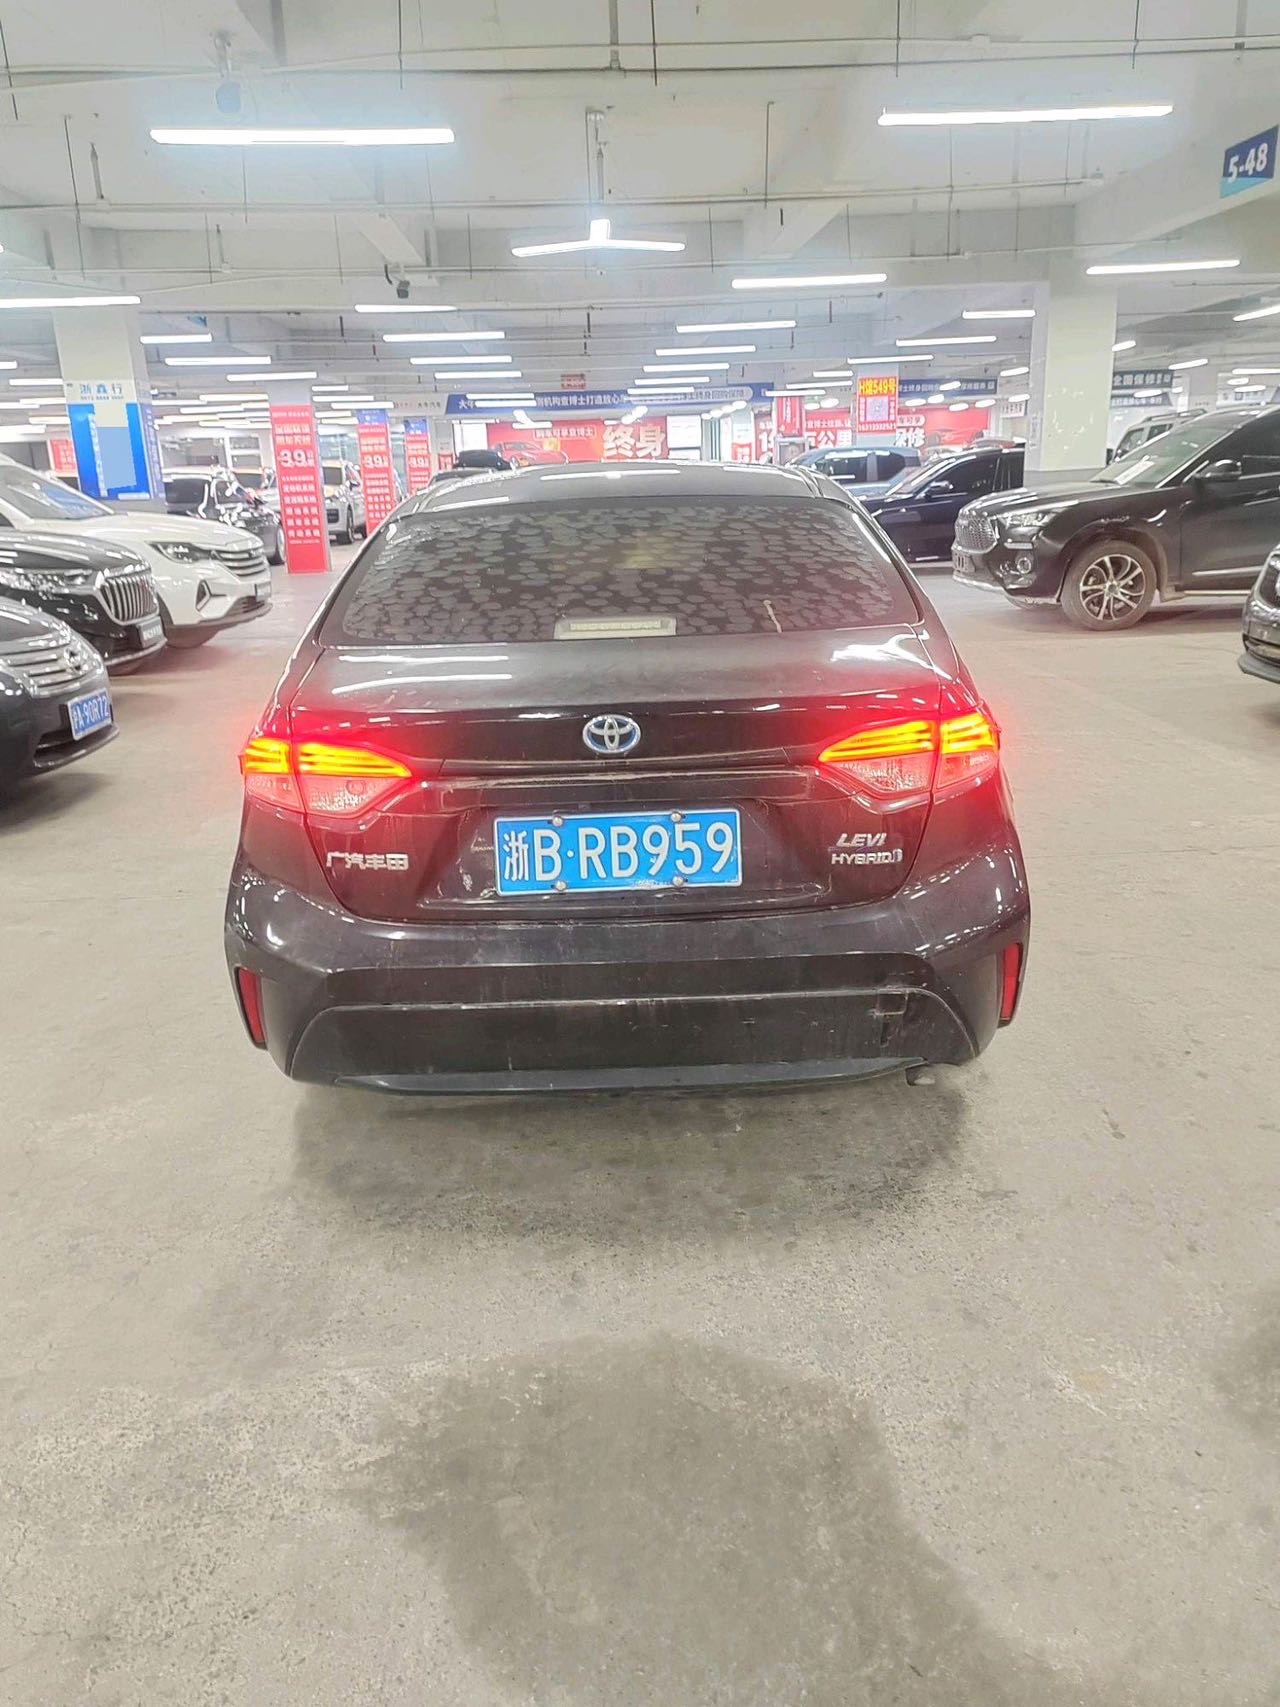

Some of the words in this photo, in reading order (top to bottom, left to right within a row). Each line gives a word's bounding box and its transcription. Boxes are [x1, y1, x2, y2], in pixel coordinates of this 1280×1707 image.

[1228, 142, 1268, 183] 5-48
[603, 424, 666, 458] 终身
[503, 821, 734, 881] 浙B·RB959
[836, 833, 887, 847] LEVI
[326, 851, 409, 871] 广汽丰田
[831, 851, 892, 865] HYBRID
